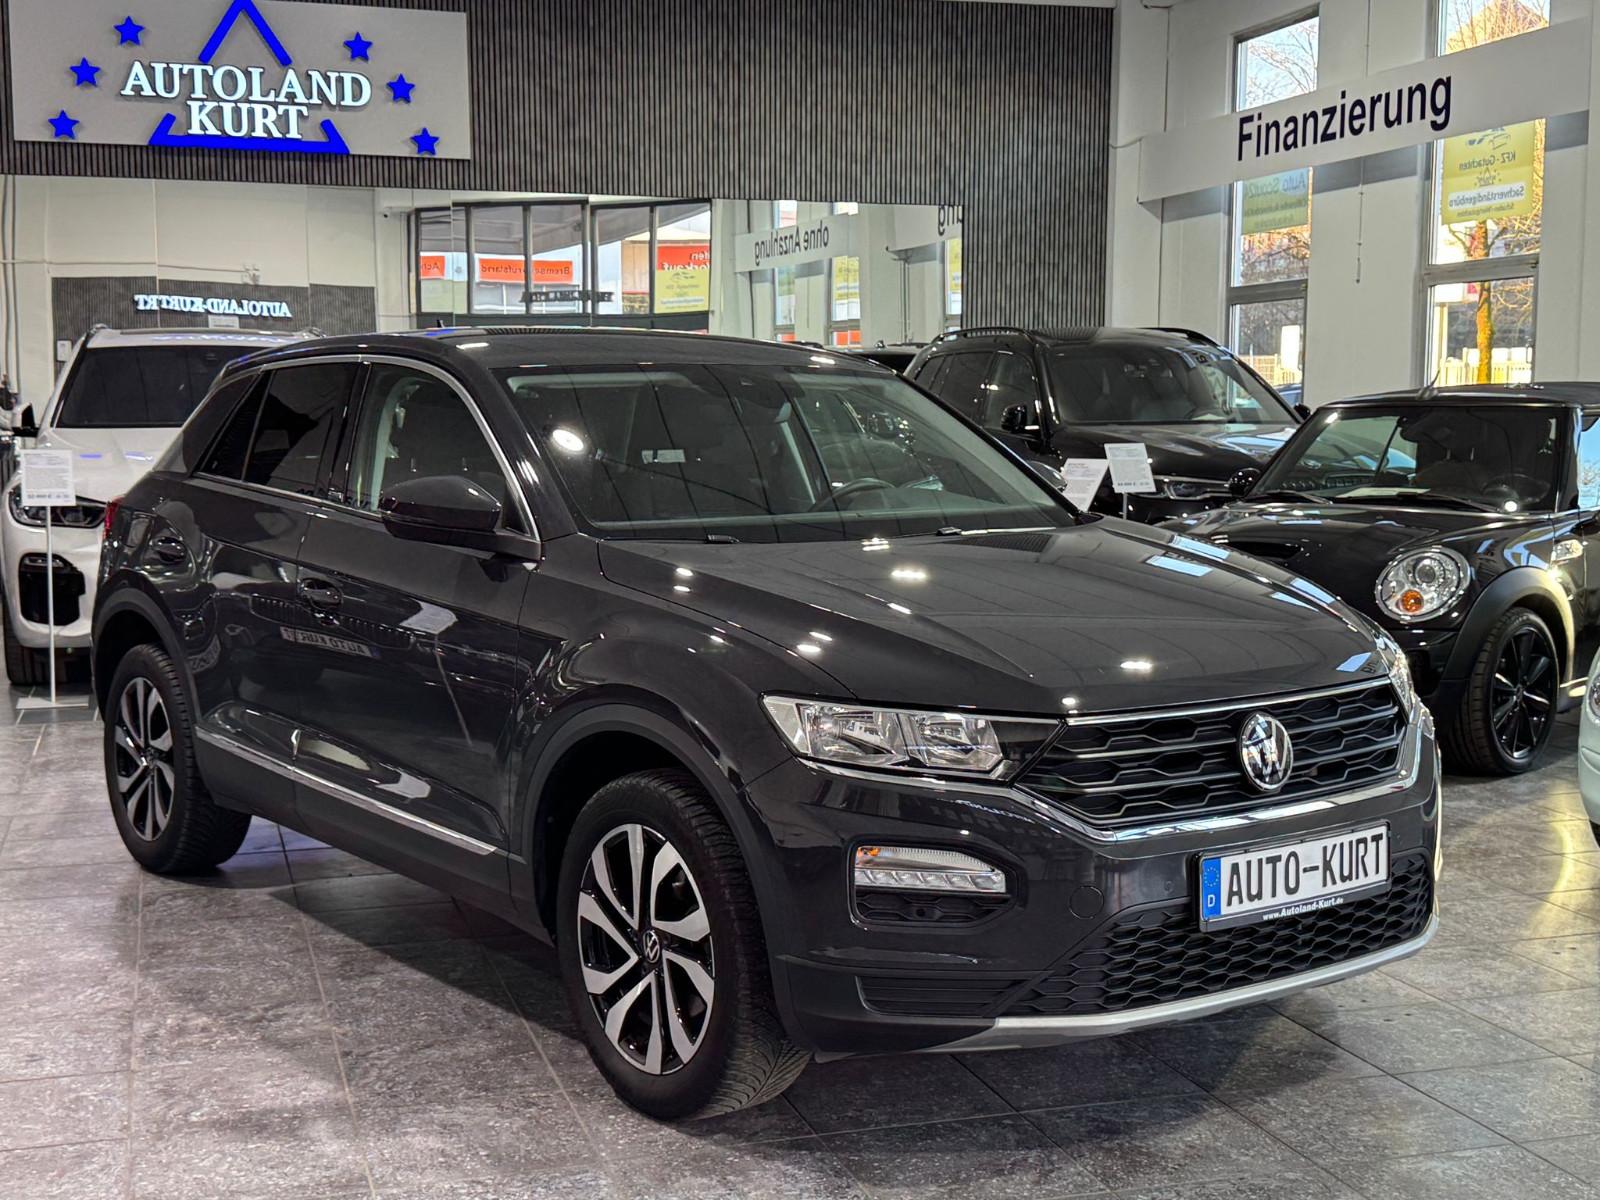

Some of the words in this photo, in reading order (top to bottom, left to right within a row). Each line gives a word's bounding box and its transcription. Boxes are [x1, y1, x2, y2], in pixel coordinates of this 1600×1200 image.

[120, 60, 372, 107] AUTOLAND
[186, 100, 309, 140] KURT
[1237, 76, 1452, 161] Finanzierung
[1226, 833, 1384, 906] AUTO-KURT
[1262, 897, 1345, 921] www.Autoland-Kurt.de
